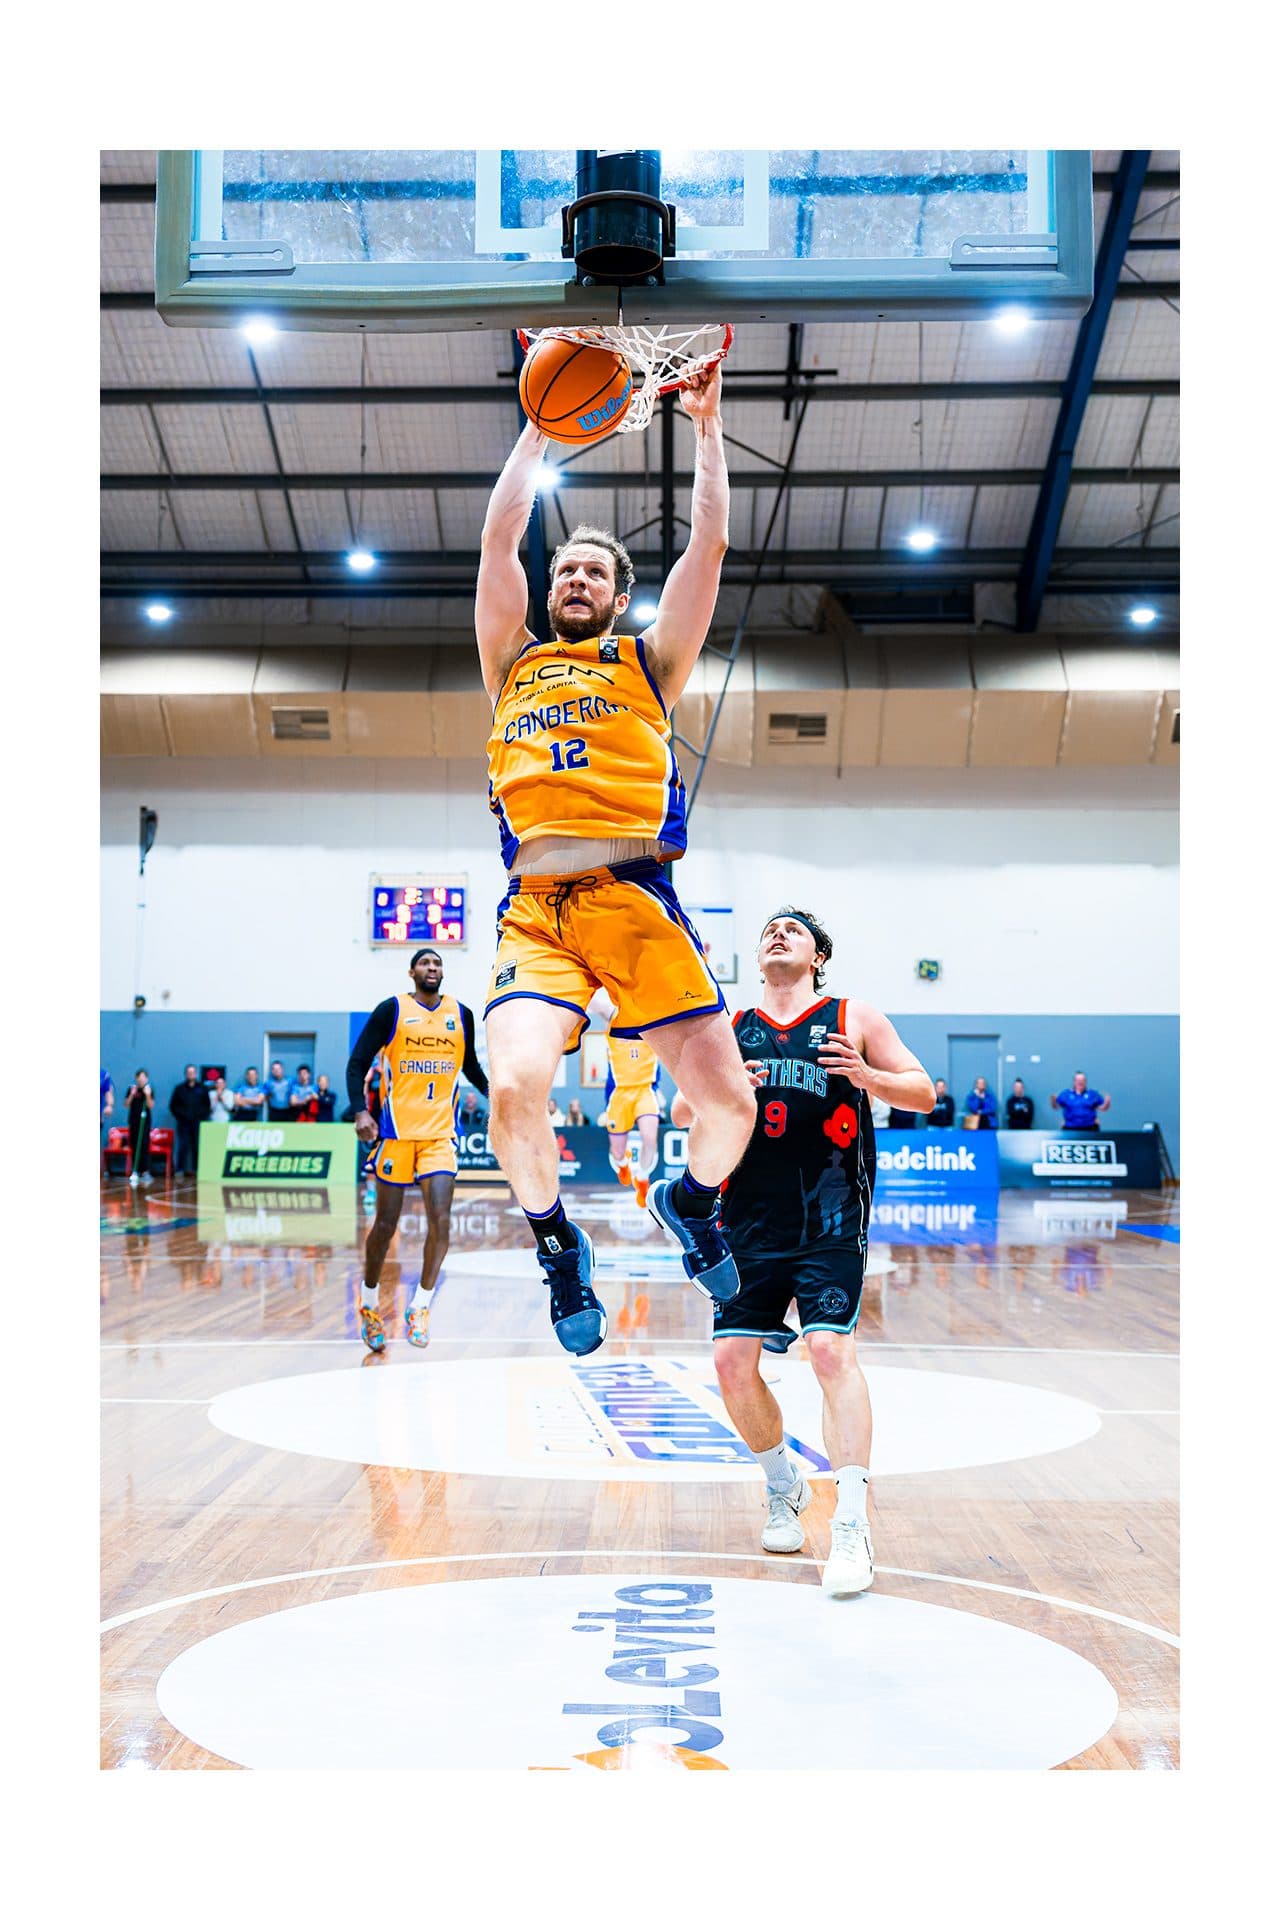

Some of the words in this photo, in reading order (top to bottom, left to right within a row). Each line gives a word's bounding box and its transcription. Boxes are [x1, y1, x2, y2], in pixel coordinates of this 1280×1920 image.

[514, 664, 615, 695] NCM
[549, 738, 590, 773] 12
[405, 1036, 455, 1047] NCM
[426, 1081, 434, 1100] 1
[764, 1101, 787, 1138] 9
[226, 1124, 285, 1156] Kayo
[229, 1156, 324, 1173] FREEBIES
[1048, 1145, 1108, 1163] RESET
